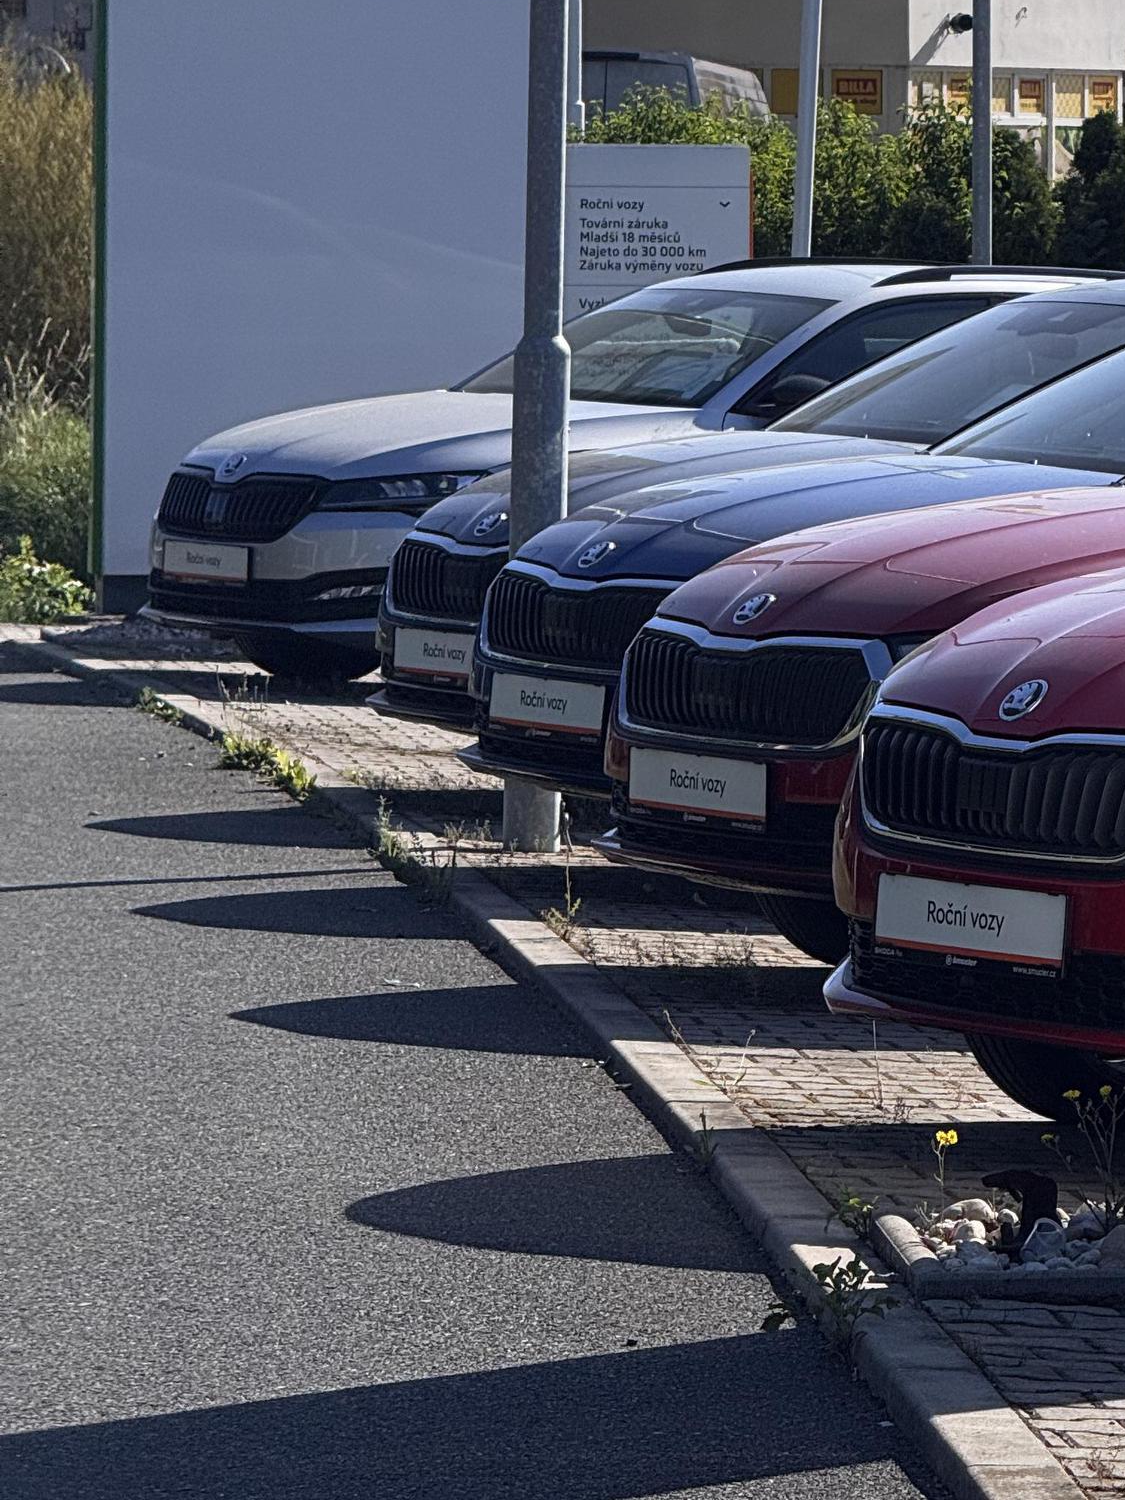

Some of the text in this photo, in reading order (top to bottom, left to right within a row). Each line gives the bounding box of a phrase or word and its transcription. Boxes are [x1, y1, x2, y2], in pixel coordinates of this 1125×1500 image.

[580, 198, 645, 212] Roční vozy
[580, 217, 668, 229] Tovární záruka
[580, 231, 681, 243] Mladší 18 měsíců
[580, 245, 707, 259] Najeto do 30 000 km
[579, 259, 704, 274] Záruka výměny vozu
[423, 642, 466, 664] Roční vozy
[520, 690, 567, 714] Roční vozy
[669, 768, 727, 798] Roční vozy
[927, 900, 1005, 937] Roční vozy
